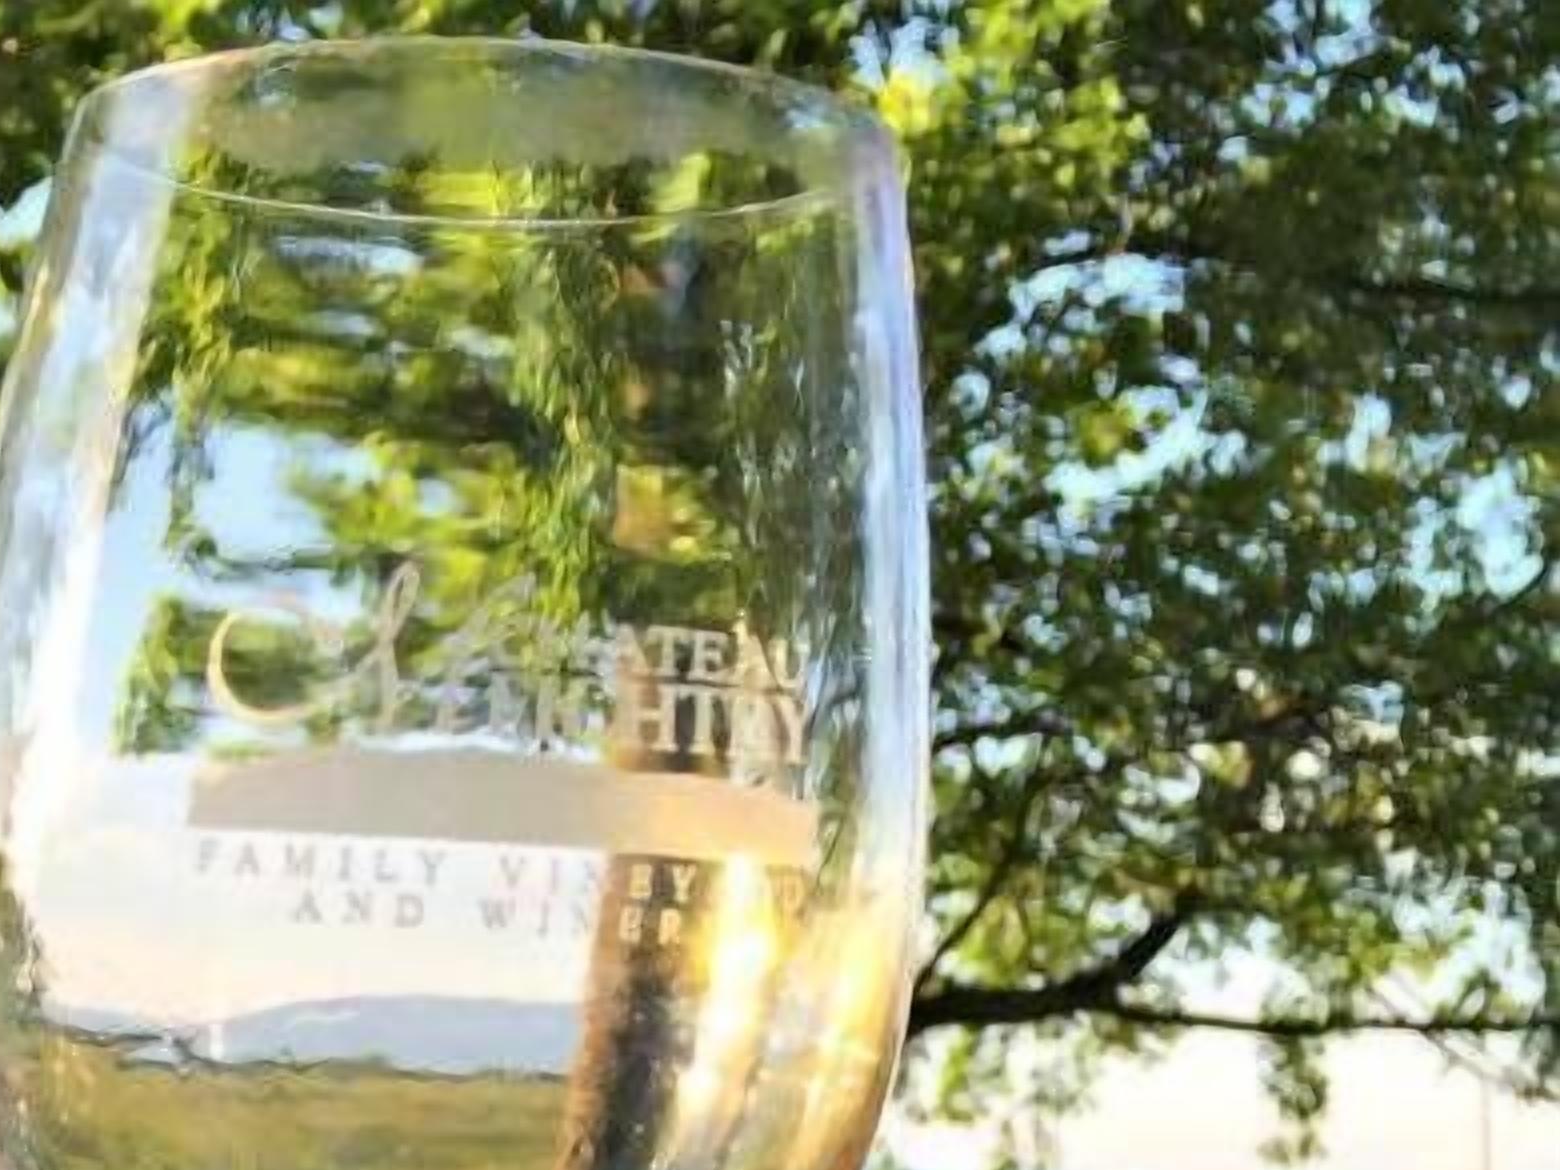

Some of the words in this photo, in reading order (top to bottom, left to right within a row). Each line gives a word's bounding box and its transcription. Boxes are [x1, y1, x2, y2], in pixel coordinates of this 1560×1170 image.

[195, 840, 448, 883] FAMILY
[288, 893, 428, 928] AND
[478, 898, 702, 948] WINER
